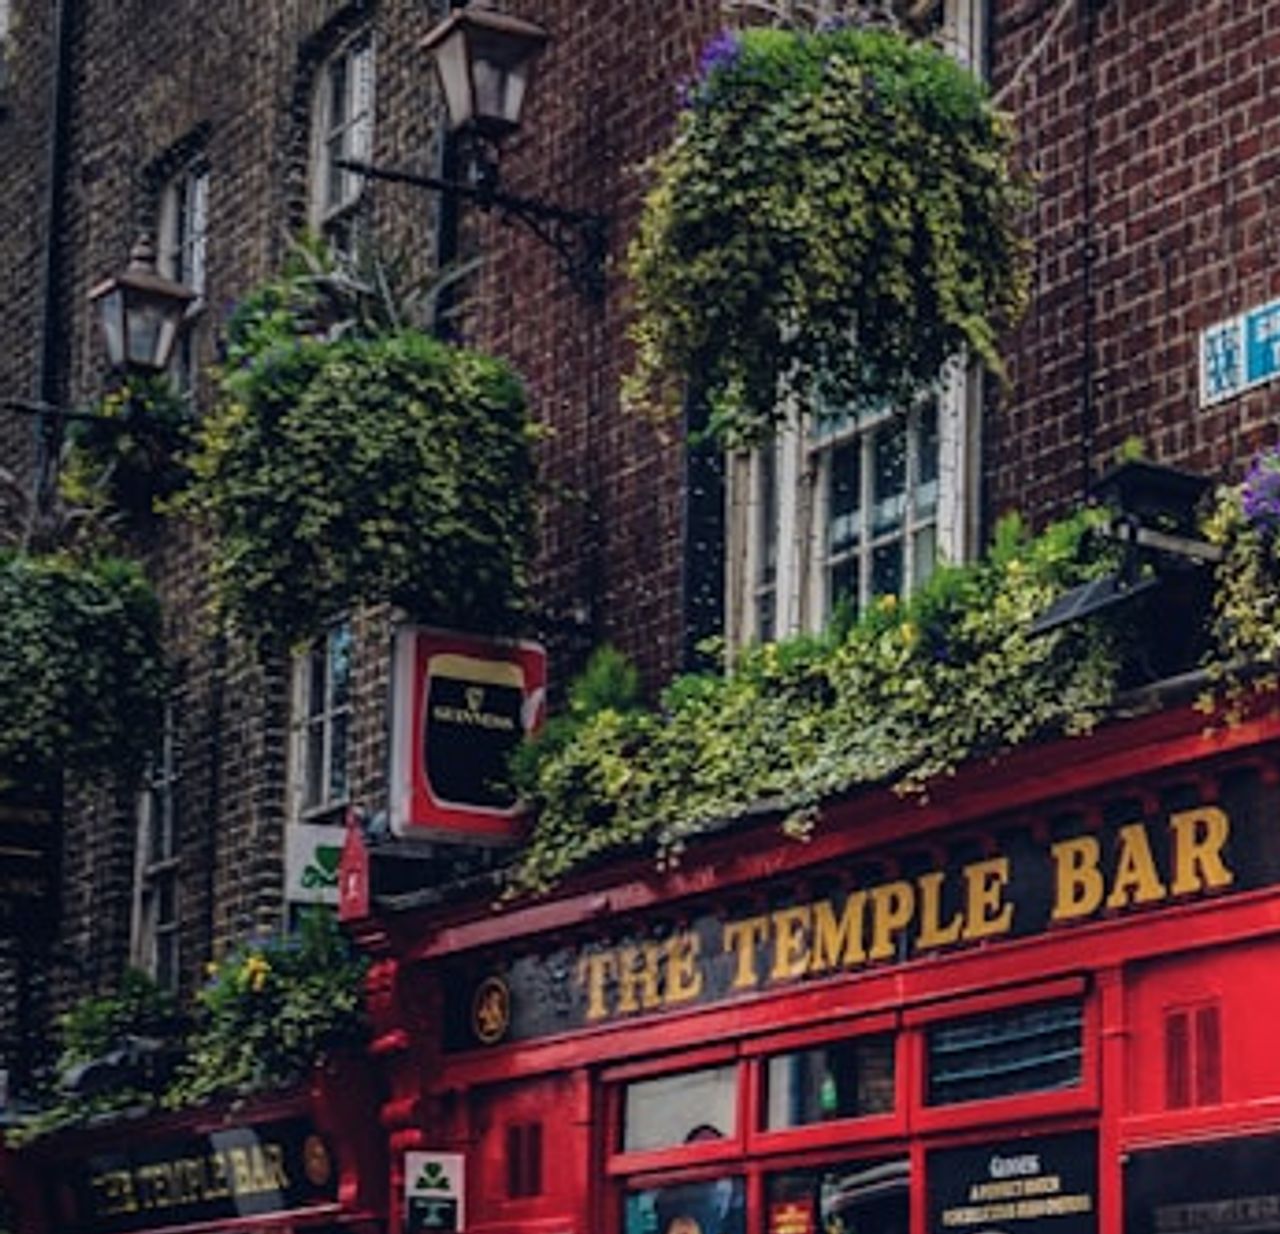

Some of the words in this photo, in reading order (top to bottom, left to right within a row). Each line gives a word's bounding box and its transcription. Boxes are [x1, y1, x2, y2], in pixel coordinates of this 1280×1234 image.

[577, 931, 704, 1020] THE
[723, 859, 1015, 989] TEMPLE
[1051, 806, 1233, 919] BAR
[229, 1143, 290, 1194] BAR
